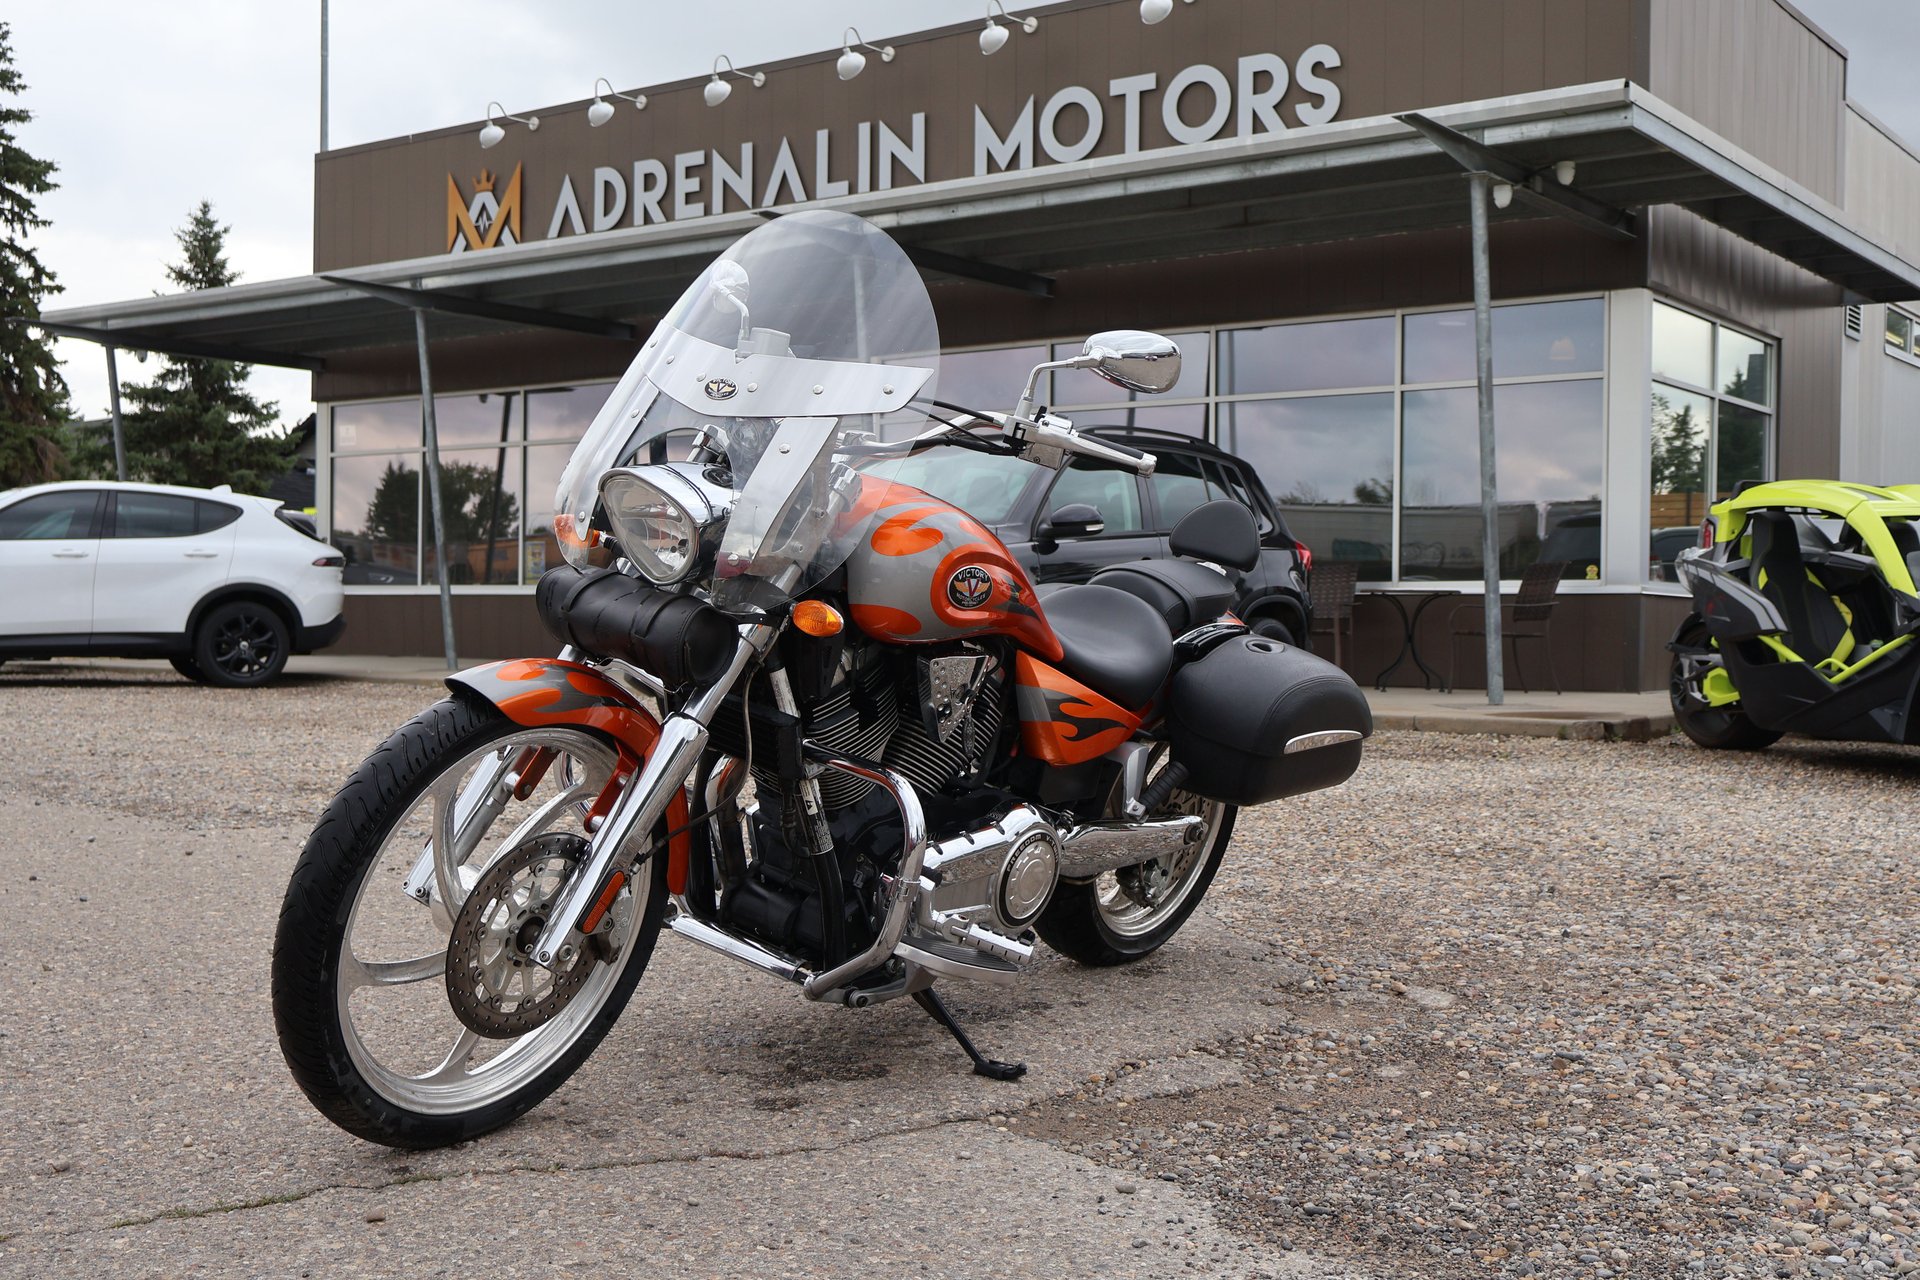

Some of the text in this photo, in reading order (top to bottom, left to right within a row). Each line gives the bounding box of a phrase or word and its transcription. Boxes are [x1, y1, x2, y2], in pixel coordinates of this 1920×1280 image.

[547, 43, 1342, 239] ADRENALIN MOTORS
[958, 568, 988, 582] VICTORY
[1006, 834, 1042, 872] FREEDOM
